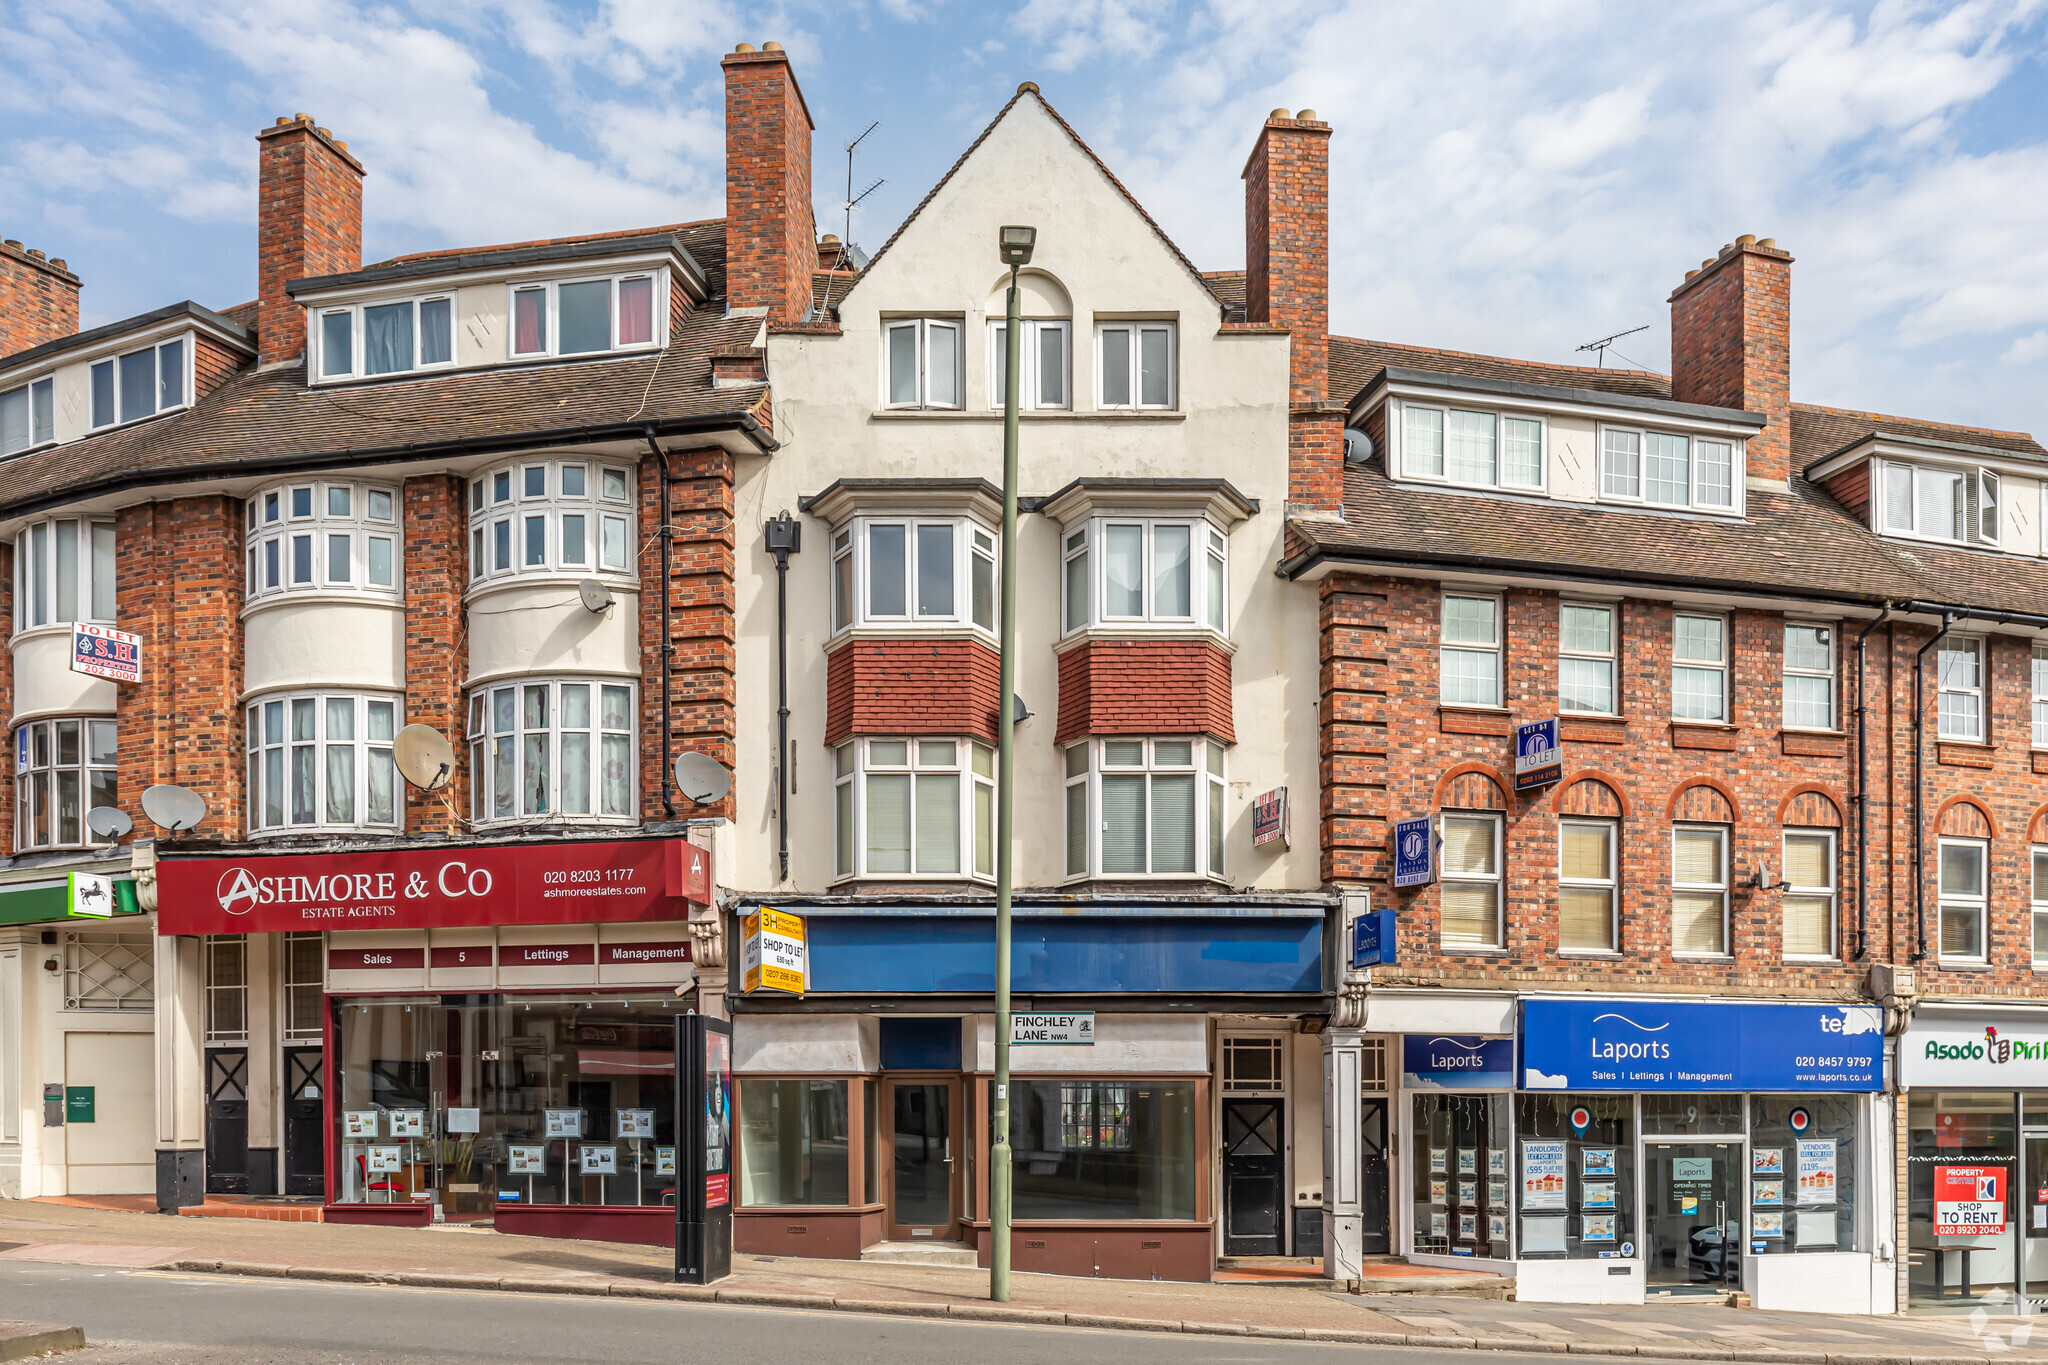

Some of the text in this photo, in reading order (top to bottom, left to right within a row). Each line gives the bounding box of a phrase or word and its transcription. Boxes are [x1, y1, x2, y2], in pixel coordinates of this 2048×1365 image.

[78, 624, 135, 643] TO LET
[95, 638, 137, 663] S.H.
[77, 653, 137, 672] PROPERTIES
[84, 664, 136, 681] 202 3000
[1524, 723, 1547, 734] LET BY
[1523, 750, 1555, 767] TO LET
[1520, 776, 1533, 785] 0203
[1535, 773, 1544, 781] 114
[1259, 790, 1276, 806] LET BY
[1261, 801, 1280, 824] S.H.
[1399, 821, 1428, 832] FOR SALE
[1258, 831, 1278, 845] 202 3000
[543, 868, 634, 883] 020 8203 1177
[217, 868, 397, 915] ASHMORE
[404, 871, 430, 899] &
[543, 886, 646, 898] ashmoreestates.com
[302, 905, 396, 918] ESTATE AGENTS
[763, 913, 777, 930] 3H
[778, 916, 803, 928] PROPERT
[612, 947, 685, 960] Management
[763, 938, 783, 952] SHOP
[785, 943, 793, 955] TO
[794, 945, 803, 958] LET
[363, 954, 392, 964] Sales
[458, 952, 466, 962] 5
[524, 949, 569, 962] Lettings
[765, 969, 778, 978] 0207
[1015, 1016, 1075, 1027] FINCHLEY
[1015, 1030, 1048, 1040] LANE
[1592, 1037, 1670, 1063] Laports
[1925, 1040, 1984, 1060] Asado
[2013, 1041, 2040, 1060] Piri
[1431, 1053, 1483, 1070] Laports
[1795, 1056, 1872, 1067] 020 8457 9797
[1592, 1071, 1733, 1082] Sales Lettings Management
[1795, 1073, 1872, 1082] www.laports.co.uk
[1687, 1106, 1697, 1123] 9
[1526, 1145, 1563, 1153] LANDLORDS
[1680, 1169, 1706, 1177] Laports
[1946, 1168, 1984, 1176] PROPERTY
[1946, 1177, 1975, 1185] CENTRE
[1957, 1203, 1982, 1211] SHOP
[1942, 1212, 1998, 1223] TO RENT
[1939, 1226, 1955, 1234] 020
[1956, 1226, 1977, 1234] 8920
[1979, 1226, 2000, 1234] 2040
